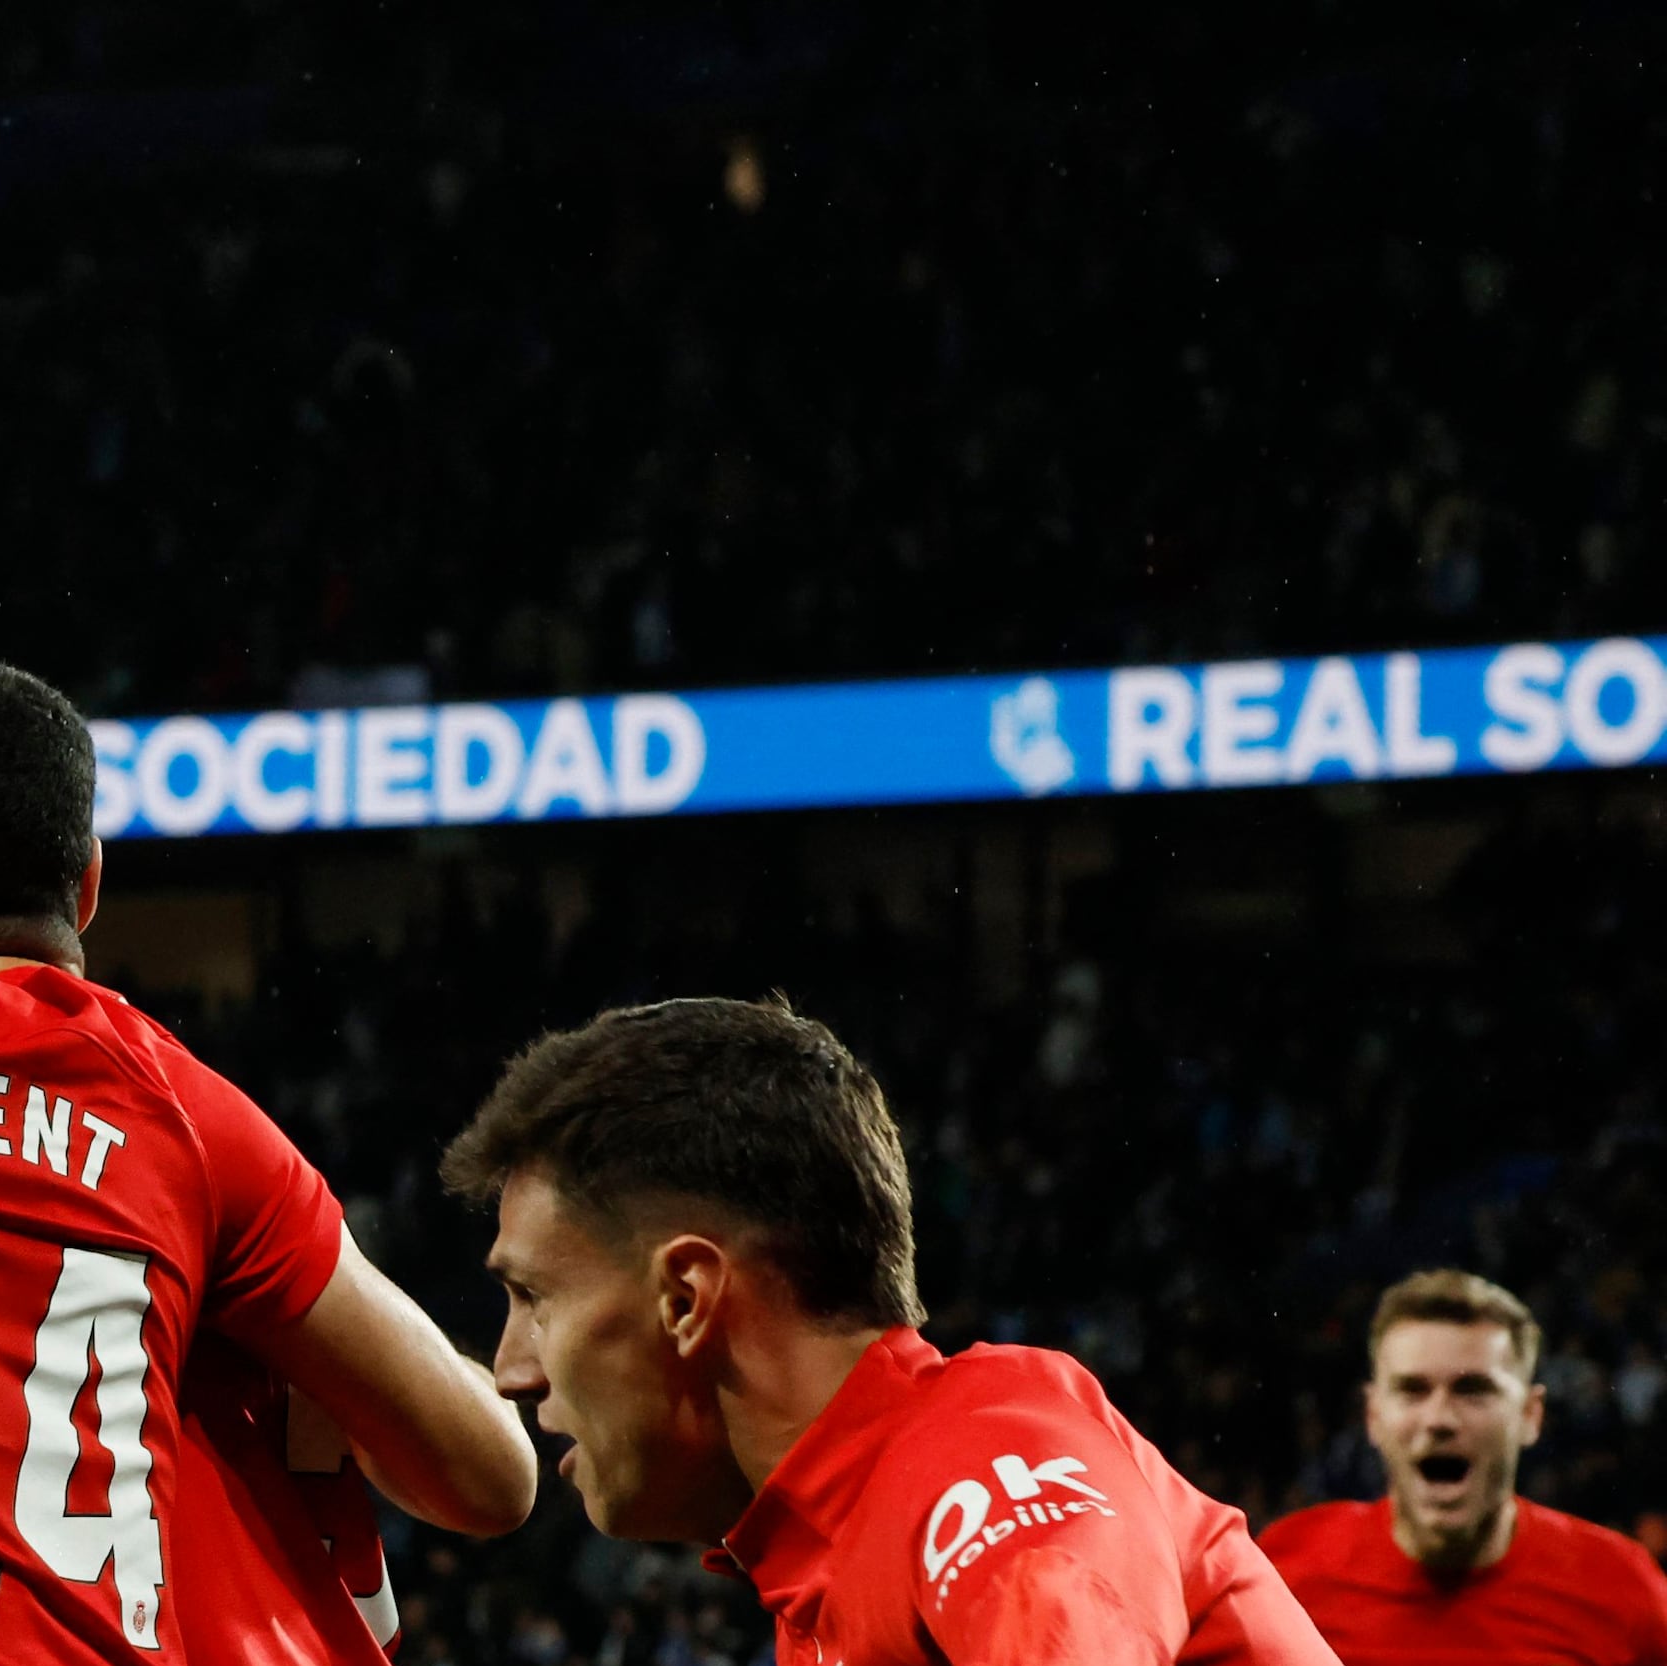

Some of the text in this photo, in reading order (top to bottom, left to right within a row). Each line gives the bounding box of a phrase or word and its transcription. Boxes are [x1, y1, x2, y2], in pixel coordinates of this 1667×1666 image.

[92, 692, 708, 839] SOCIEDAD
[1104, 651, 1458, 792] REAL
[923, 1454, 1109, 1584] OK
